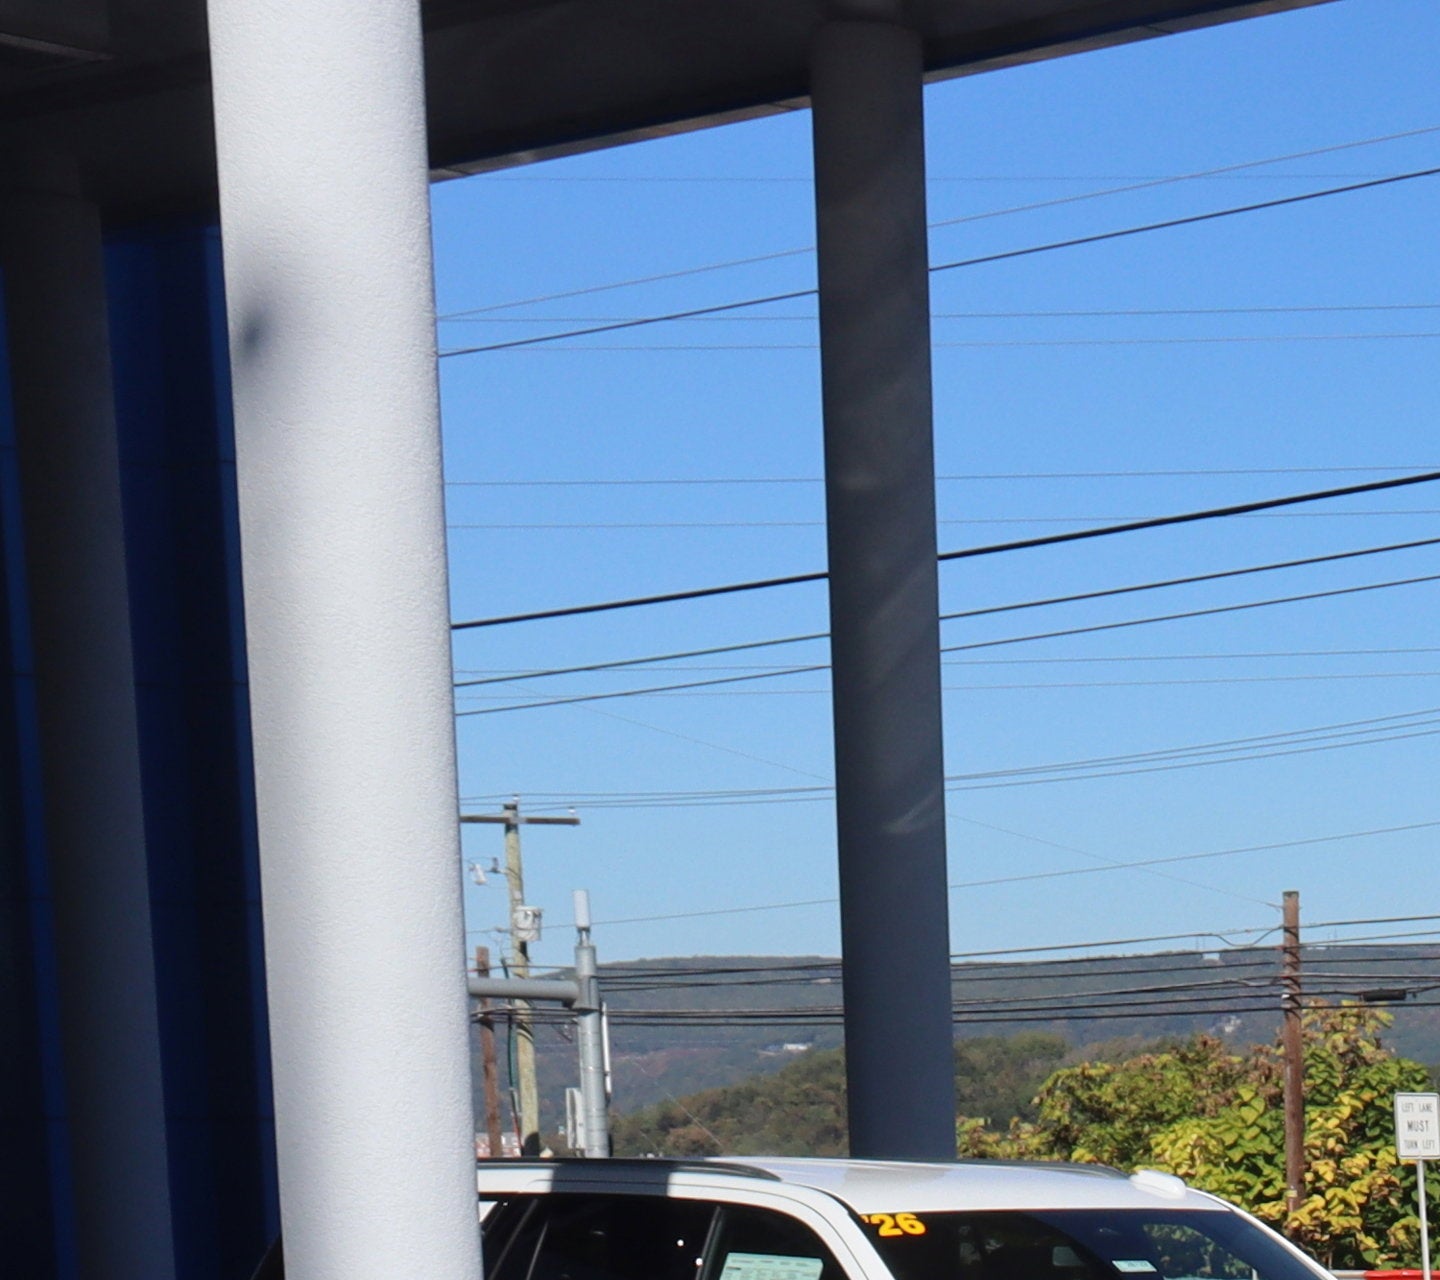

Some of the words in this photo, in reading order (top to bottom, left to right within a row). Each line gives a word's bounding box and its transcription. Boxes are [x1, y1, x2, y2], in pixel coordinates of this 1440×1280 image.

[1419, 1103, 1433, 1112] LANE
[1407, 1120, 1429, 1132] MUST
[1422, 1139, 1435, 1149] LEFT
